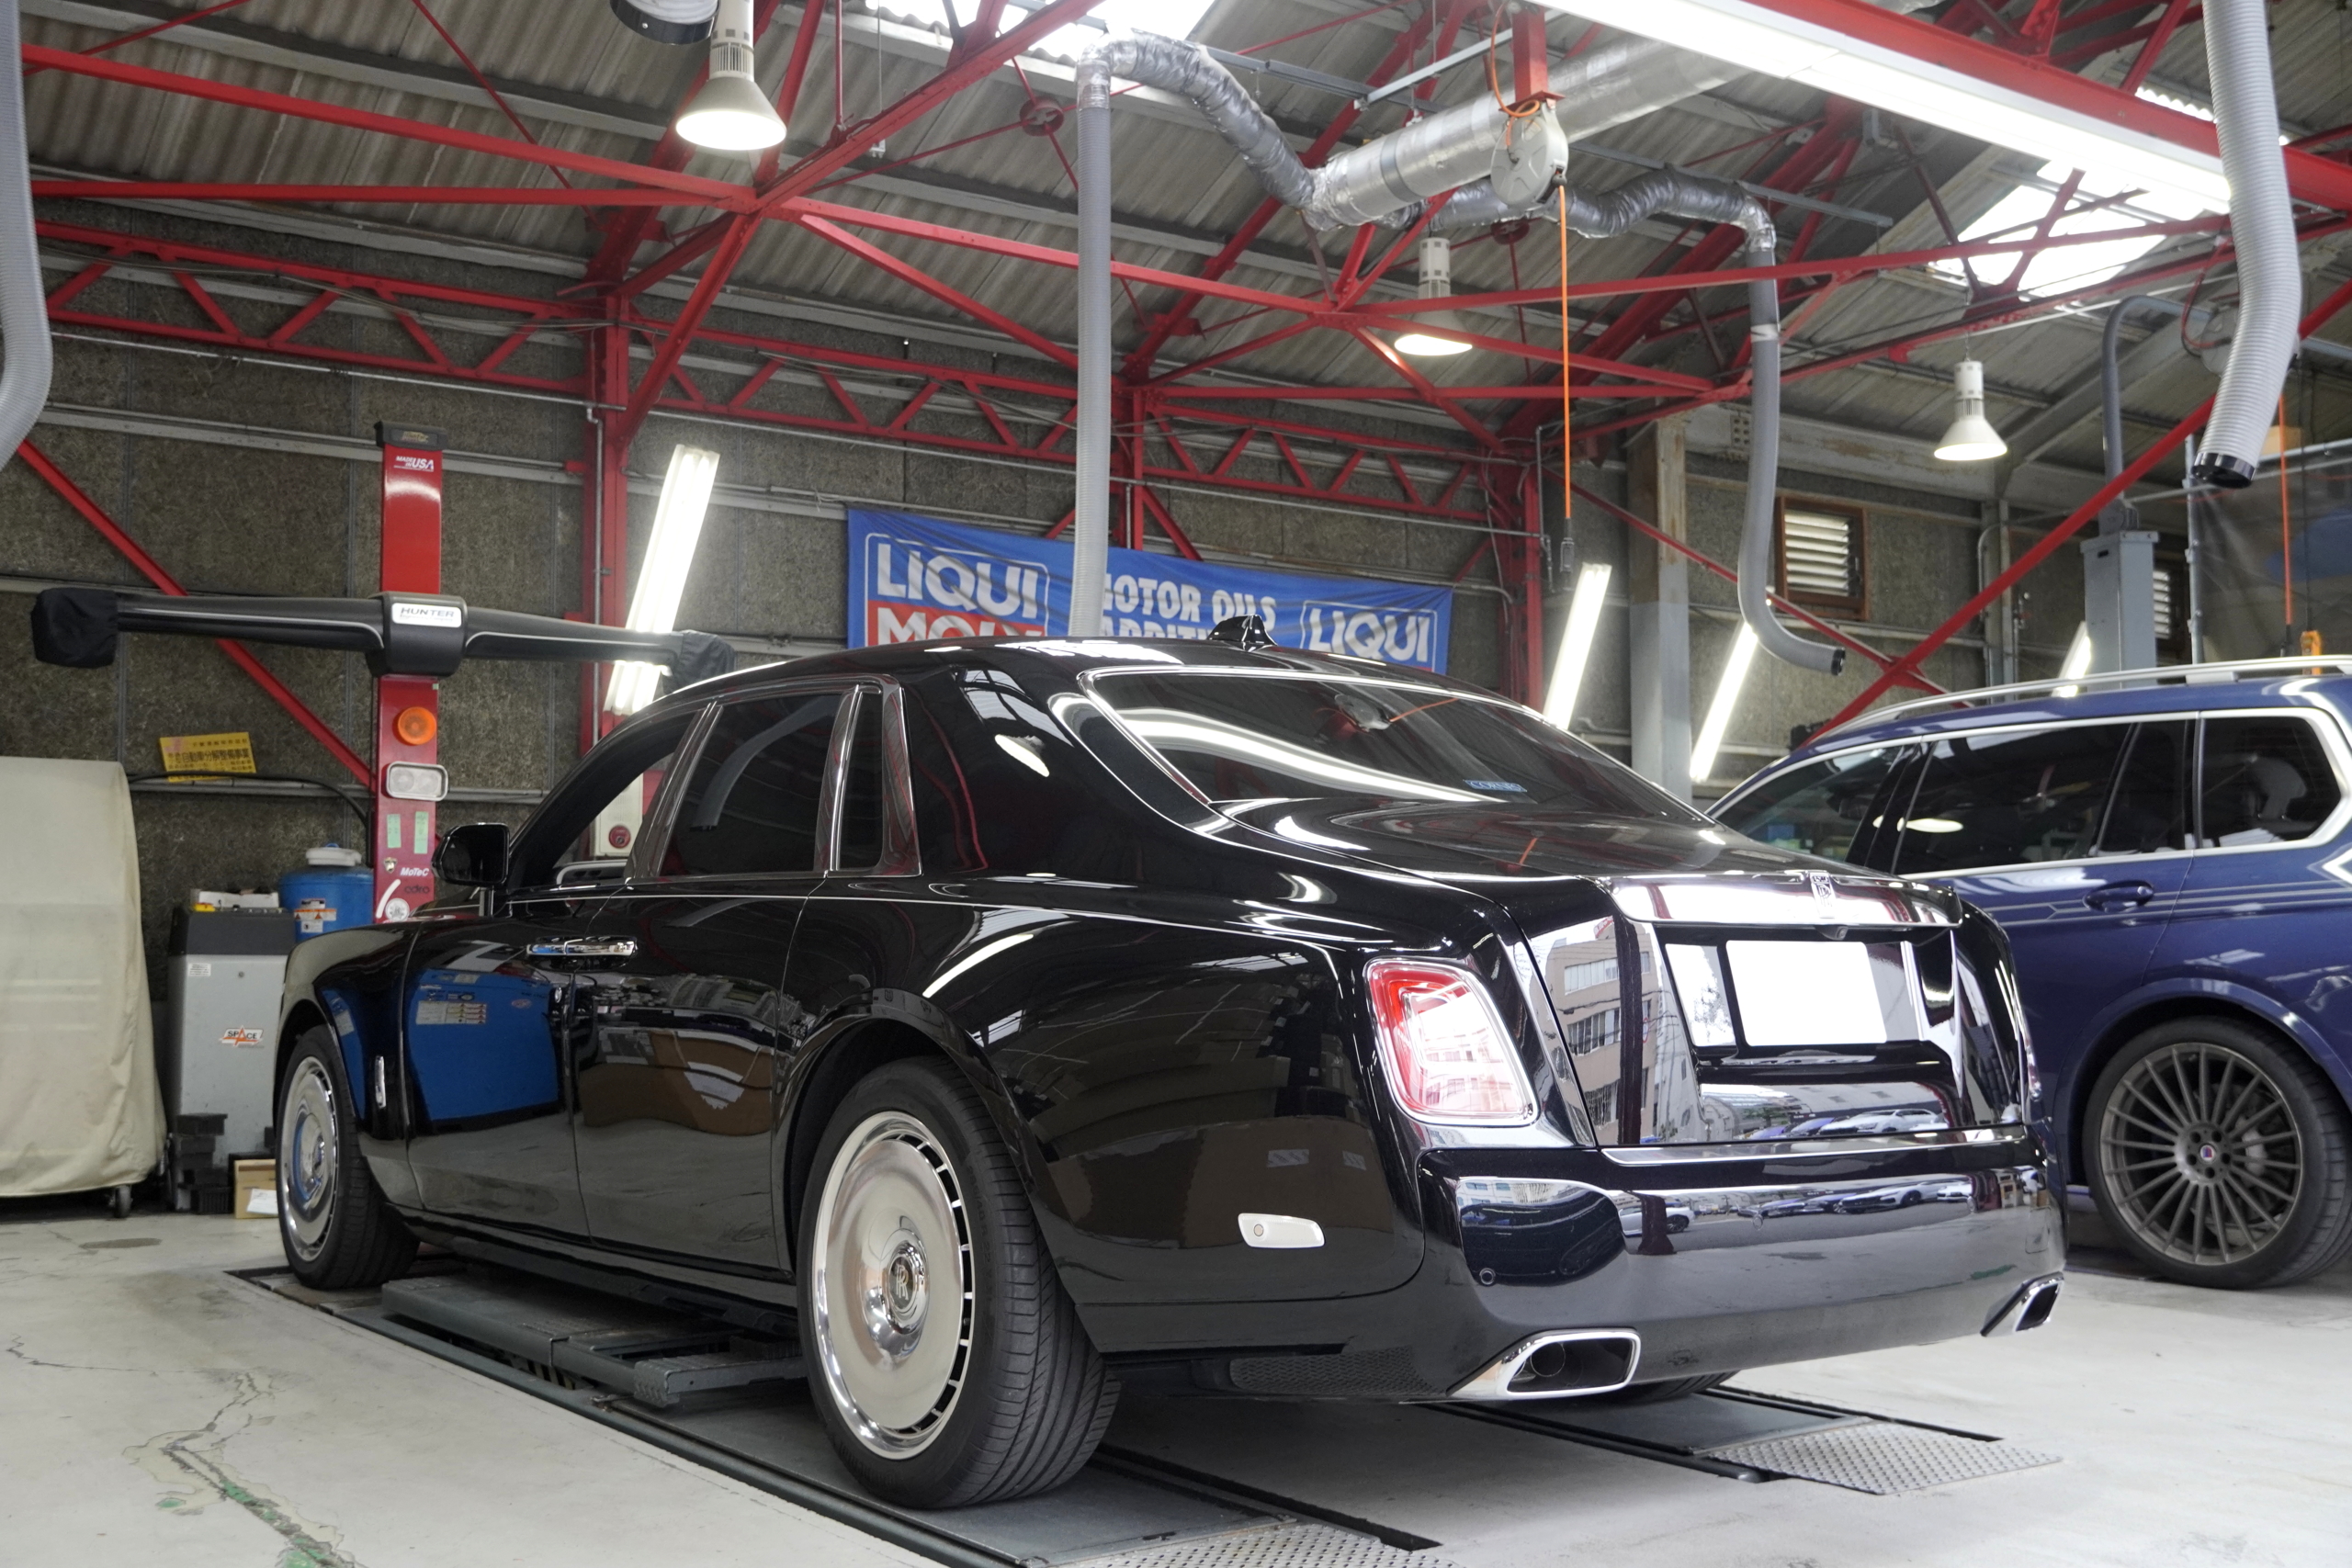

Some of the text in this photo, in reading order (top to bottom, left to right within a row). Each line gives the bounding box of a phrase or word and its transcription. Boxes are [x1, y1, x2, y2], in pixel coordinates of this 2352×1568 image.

[412, 457, 435, 470] USA
[877, 543, 1038, 619] LIQUI
[401, 607, 455, 617] HUNTER
[1308, 607, 1430, 662] LIQUI
[400, 867, 429, 876] MoTeC
[227, 1028, 258, 1041] SPACE
